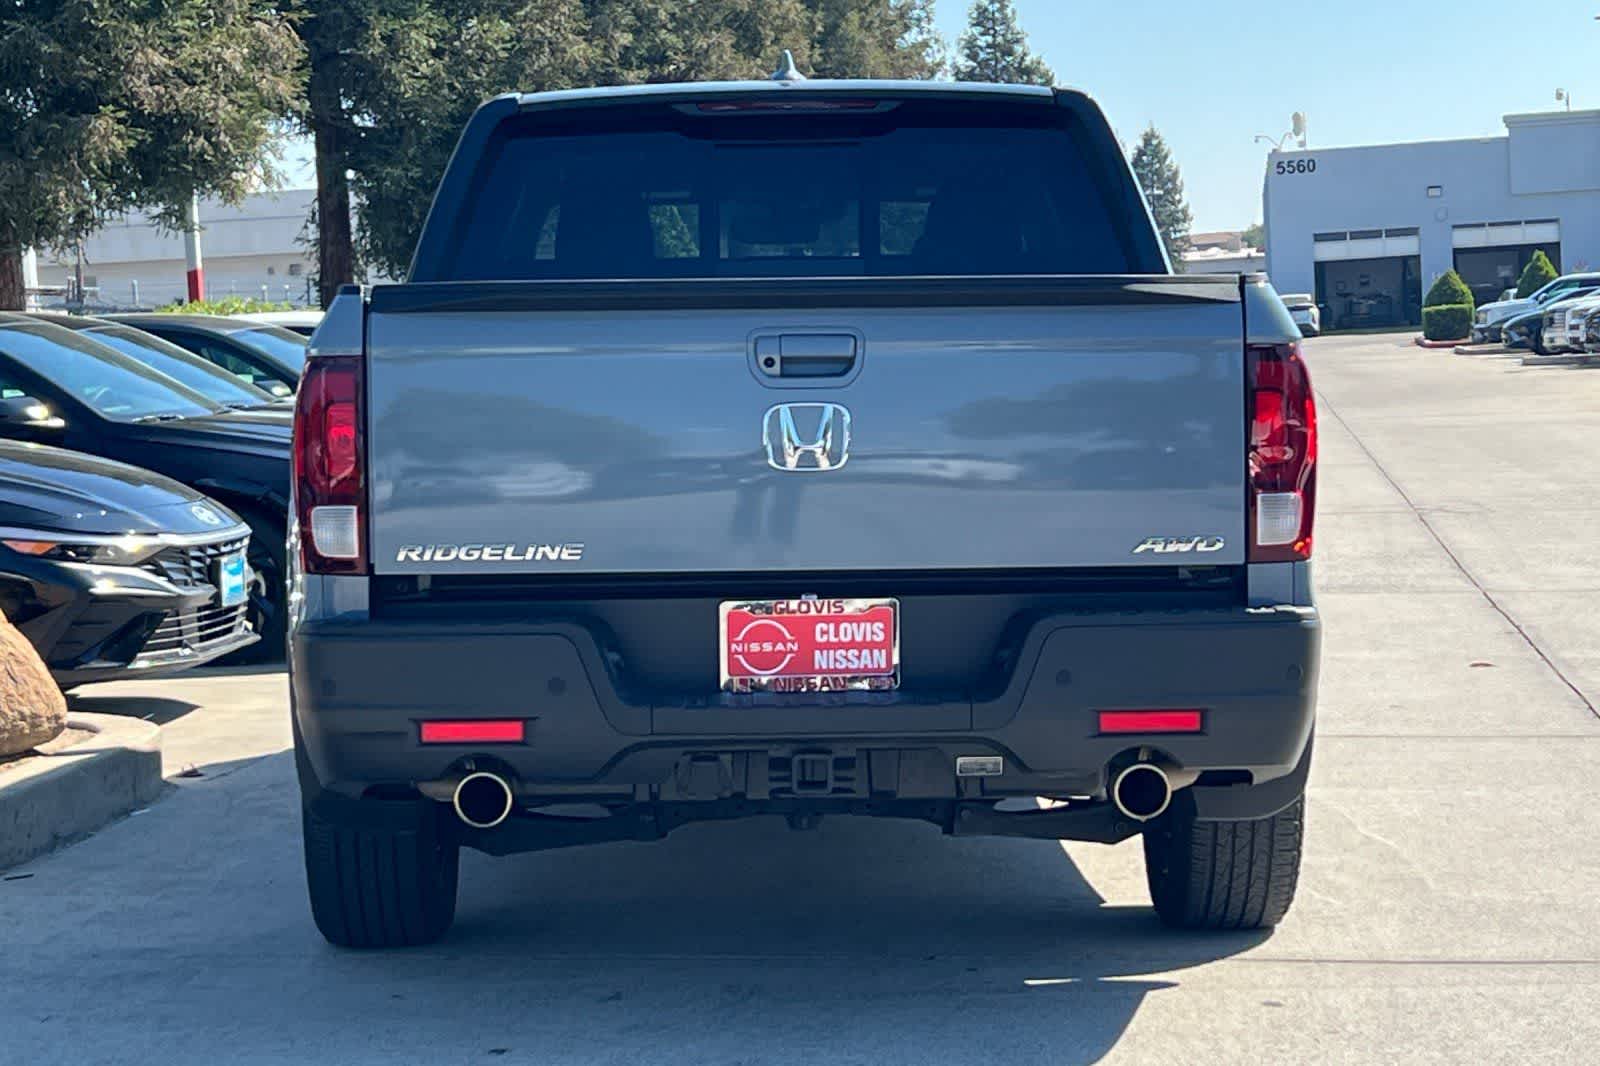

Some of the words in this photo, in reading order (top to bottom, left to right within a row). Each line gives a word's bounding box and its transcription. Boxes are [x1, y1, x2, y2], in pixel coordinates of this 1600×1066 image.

[1276, 158, 1316, 175] 5560
[396, 543, 585, 562] RIDGELINE
[1132, 536, 1225, 553] AWD
[815, 622, 885, 643] CLOVIS
[730, 641, 800, 653] NISSAN
[814, 648, 887, 670] NISSAN
